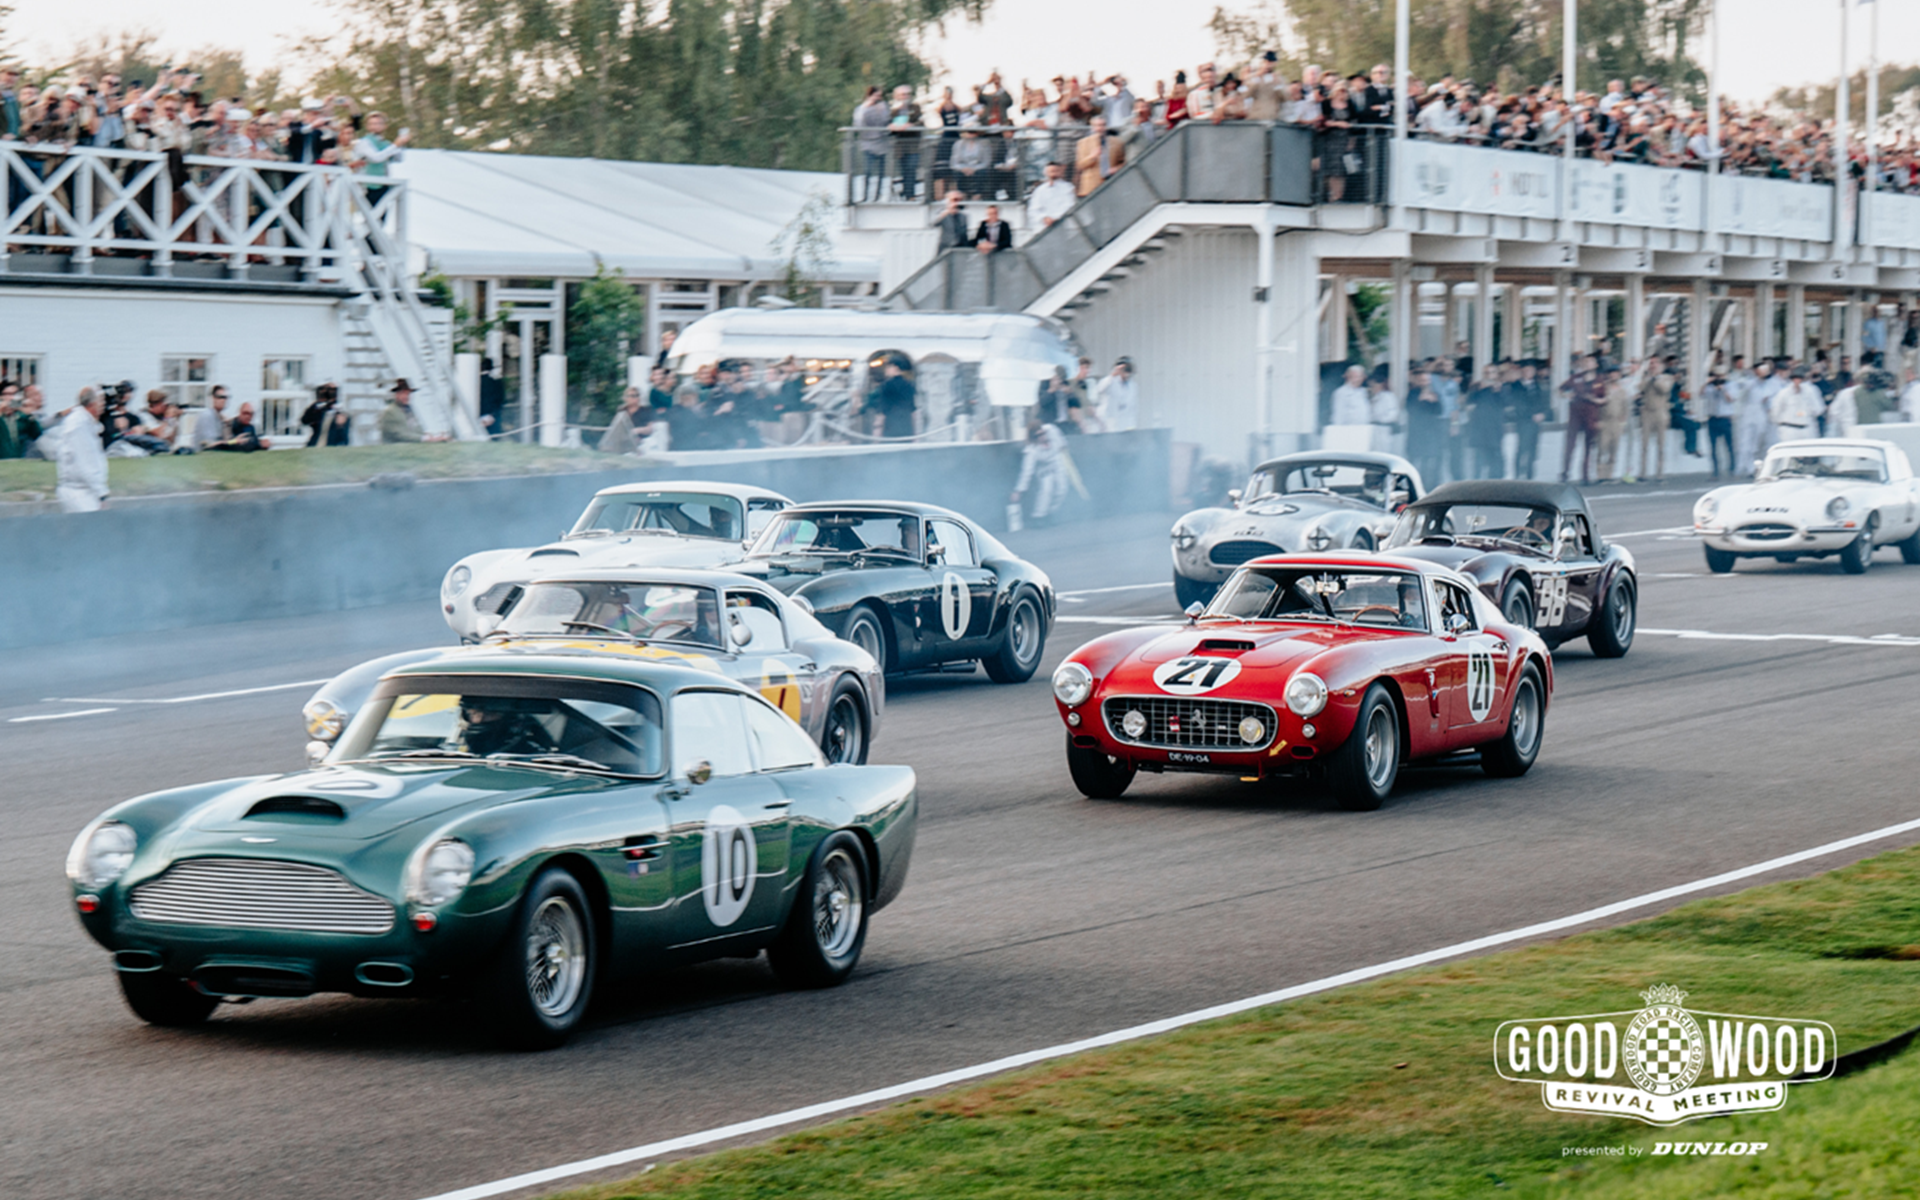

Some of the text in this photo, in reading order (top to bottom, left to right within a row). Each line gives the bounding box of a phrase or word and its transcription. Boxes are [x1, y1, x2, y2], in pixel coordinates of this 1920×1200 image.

[1561, 245, 1572, 262] 2
[1535, 577, 1568, 628] 98
[1162, 659, 1231, 688] 21
[1471, 653, 1490, 711] 21
[713, 827, 749, 906] 10
